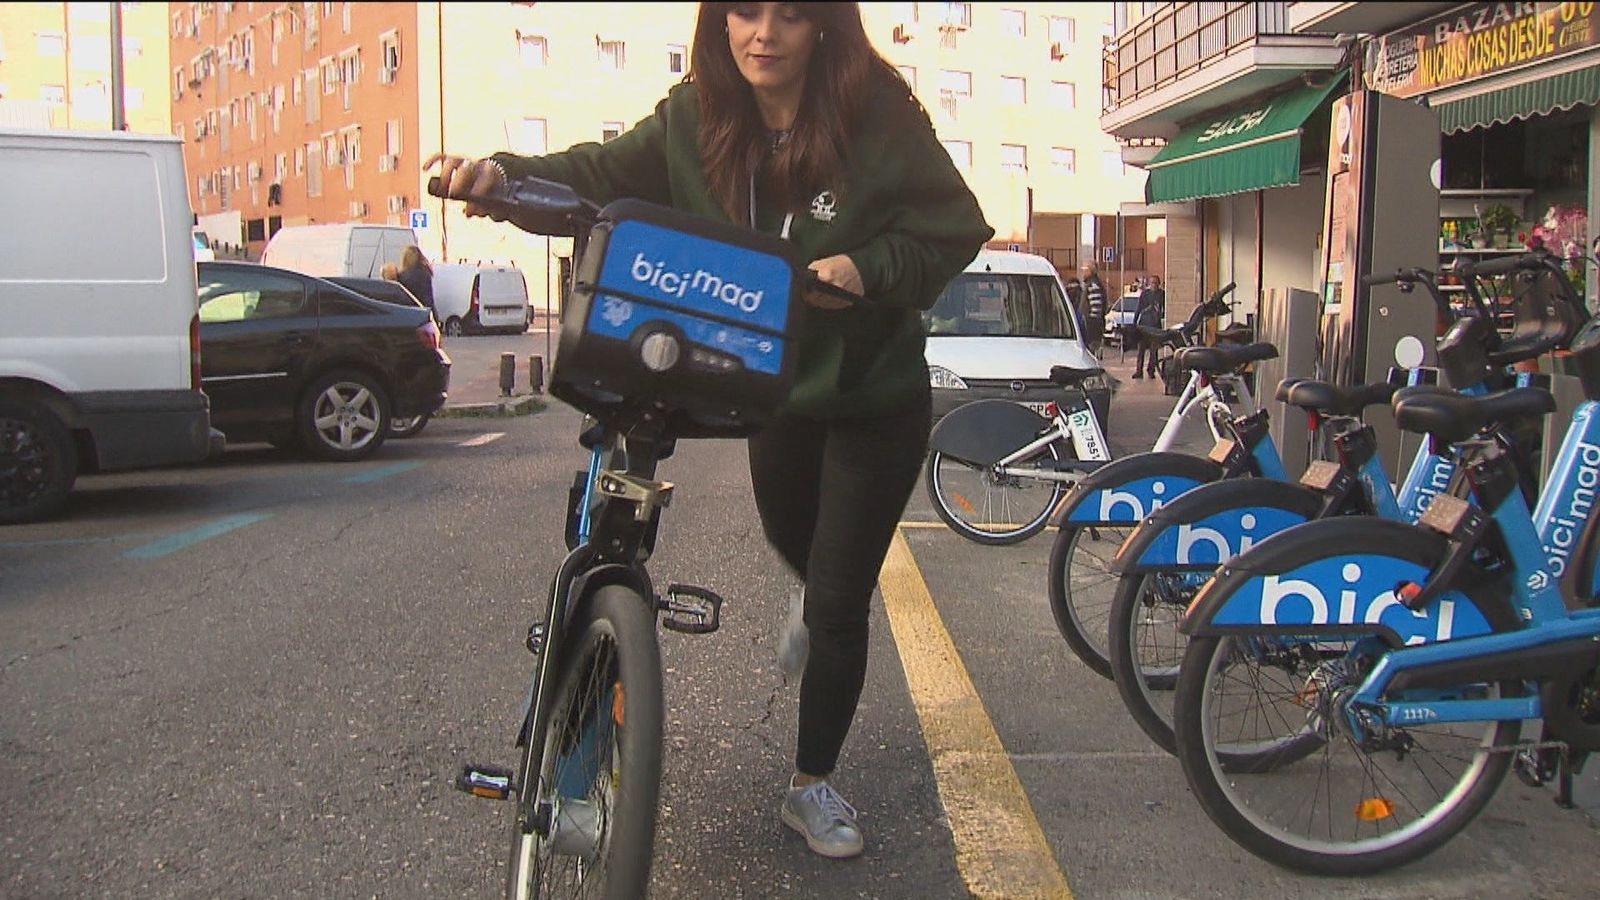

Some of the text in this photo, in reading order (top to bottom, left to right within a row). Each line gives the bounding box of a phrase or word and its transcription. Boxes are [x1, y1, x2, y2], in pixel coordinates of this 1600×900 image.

[1421, 13, 1555, 87] MUCHAS COSAS DESDE
[1085, 435, 1101, 460] 7851
